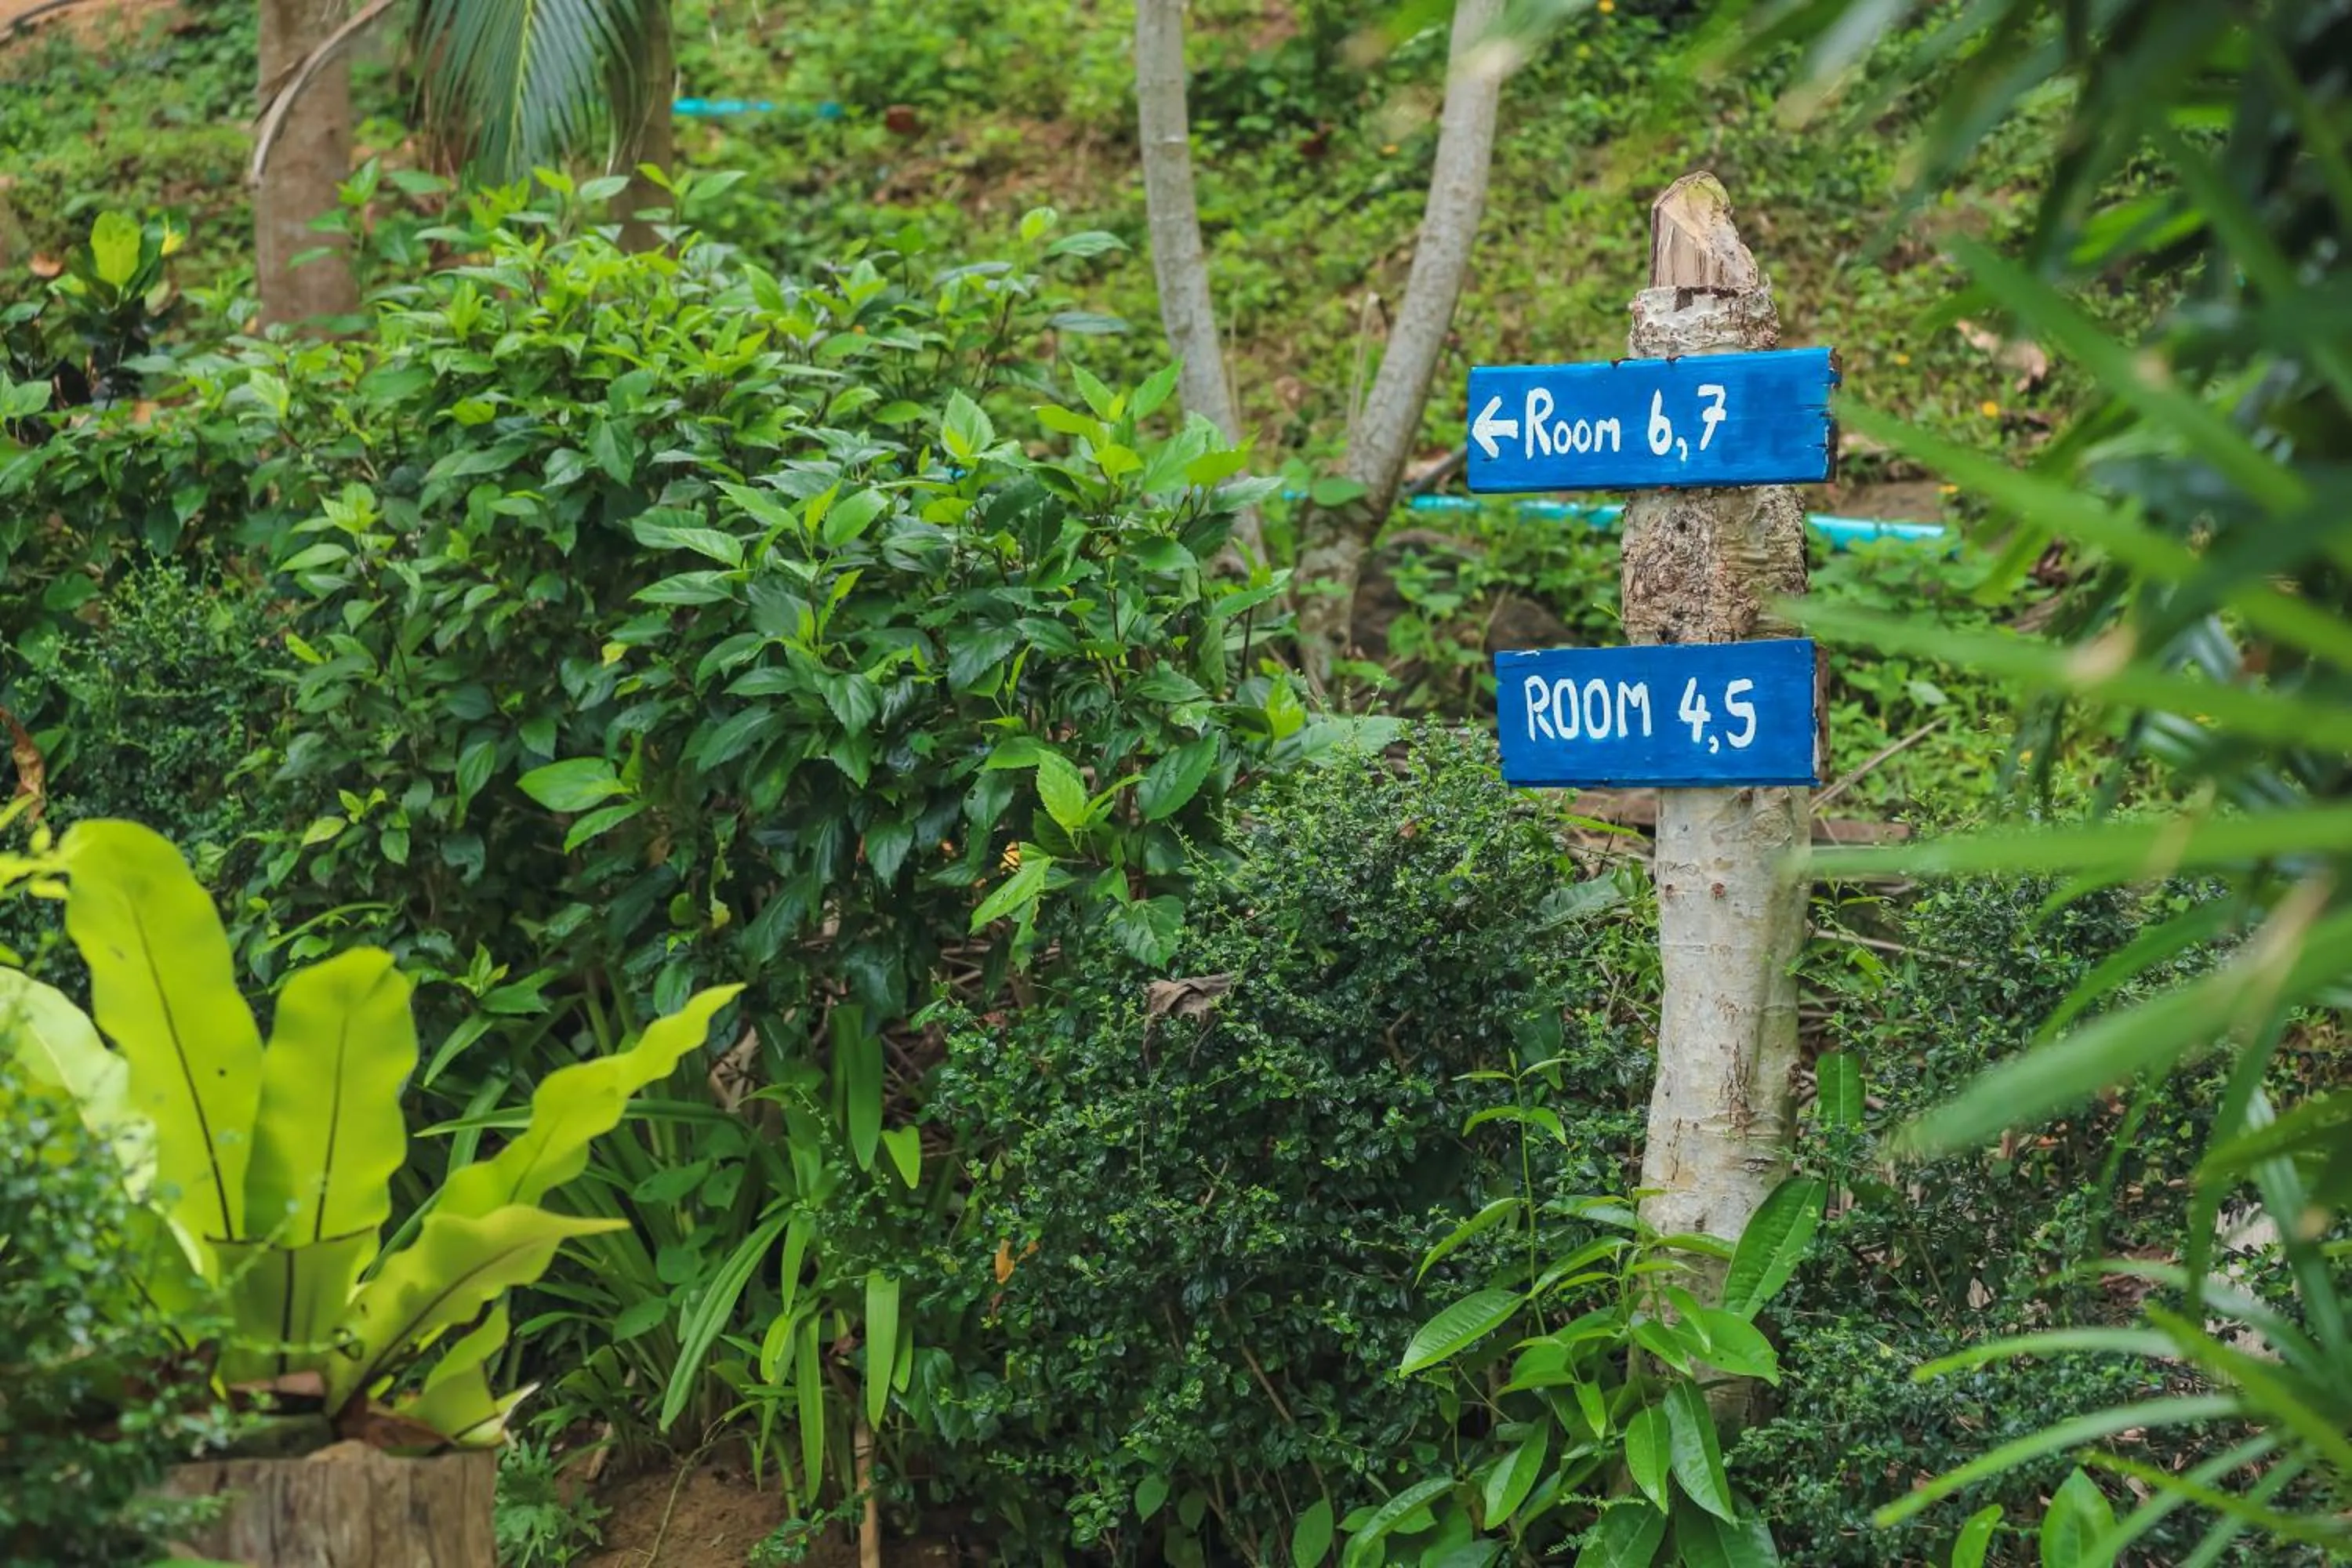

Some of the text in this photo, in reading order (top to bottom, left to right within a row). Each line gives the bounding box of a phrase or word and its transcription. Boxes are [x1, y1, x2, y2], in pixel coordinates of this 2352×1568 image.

[1524, 383, 1727, 463] Room 6,7
[1523, 674, 1757, 754] ROOM 4,5
